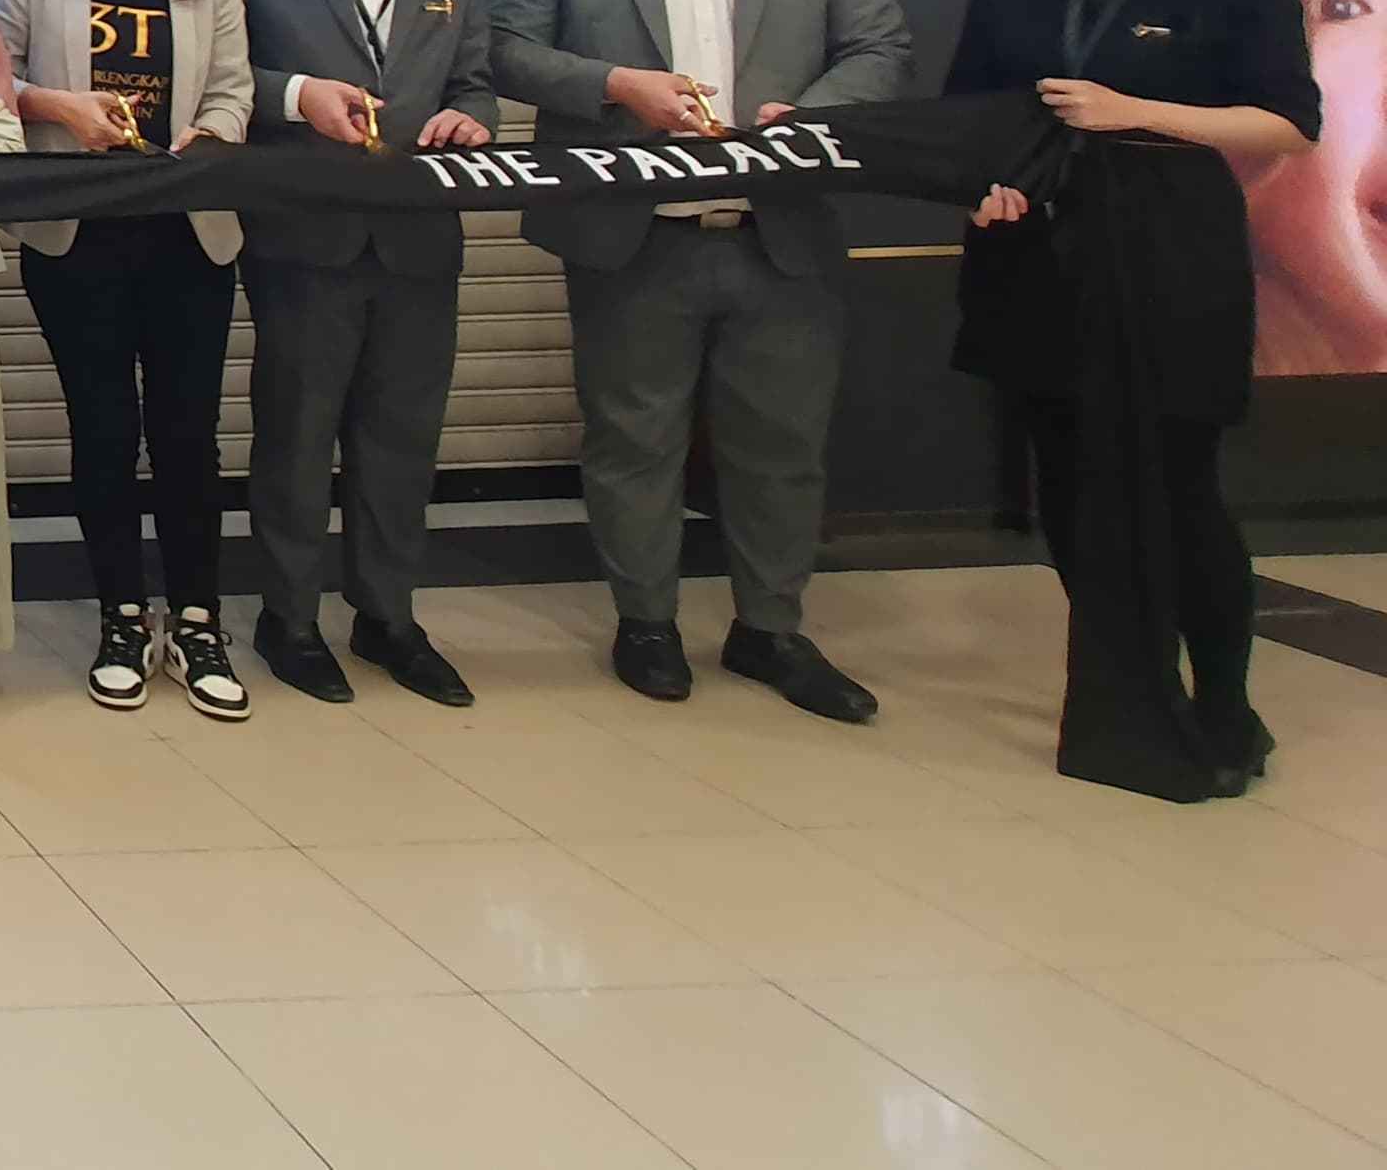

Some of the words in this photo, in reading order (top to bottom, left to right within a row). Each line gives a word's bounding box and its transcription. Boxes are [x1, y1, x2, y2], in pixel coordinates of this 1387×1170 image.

[91, 1, 168, 58] 3T
[413, 150, 562, 188] THE
[567, 121, 862, 183] PALACE
